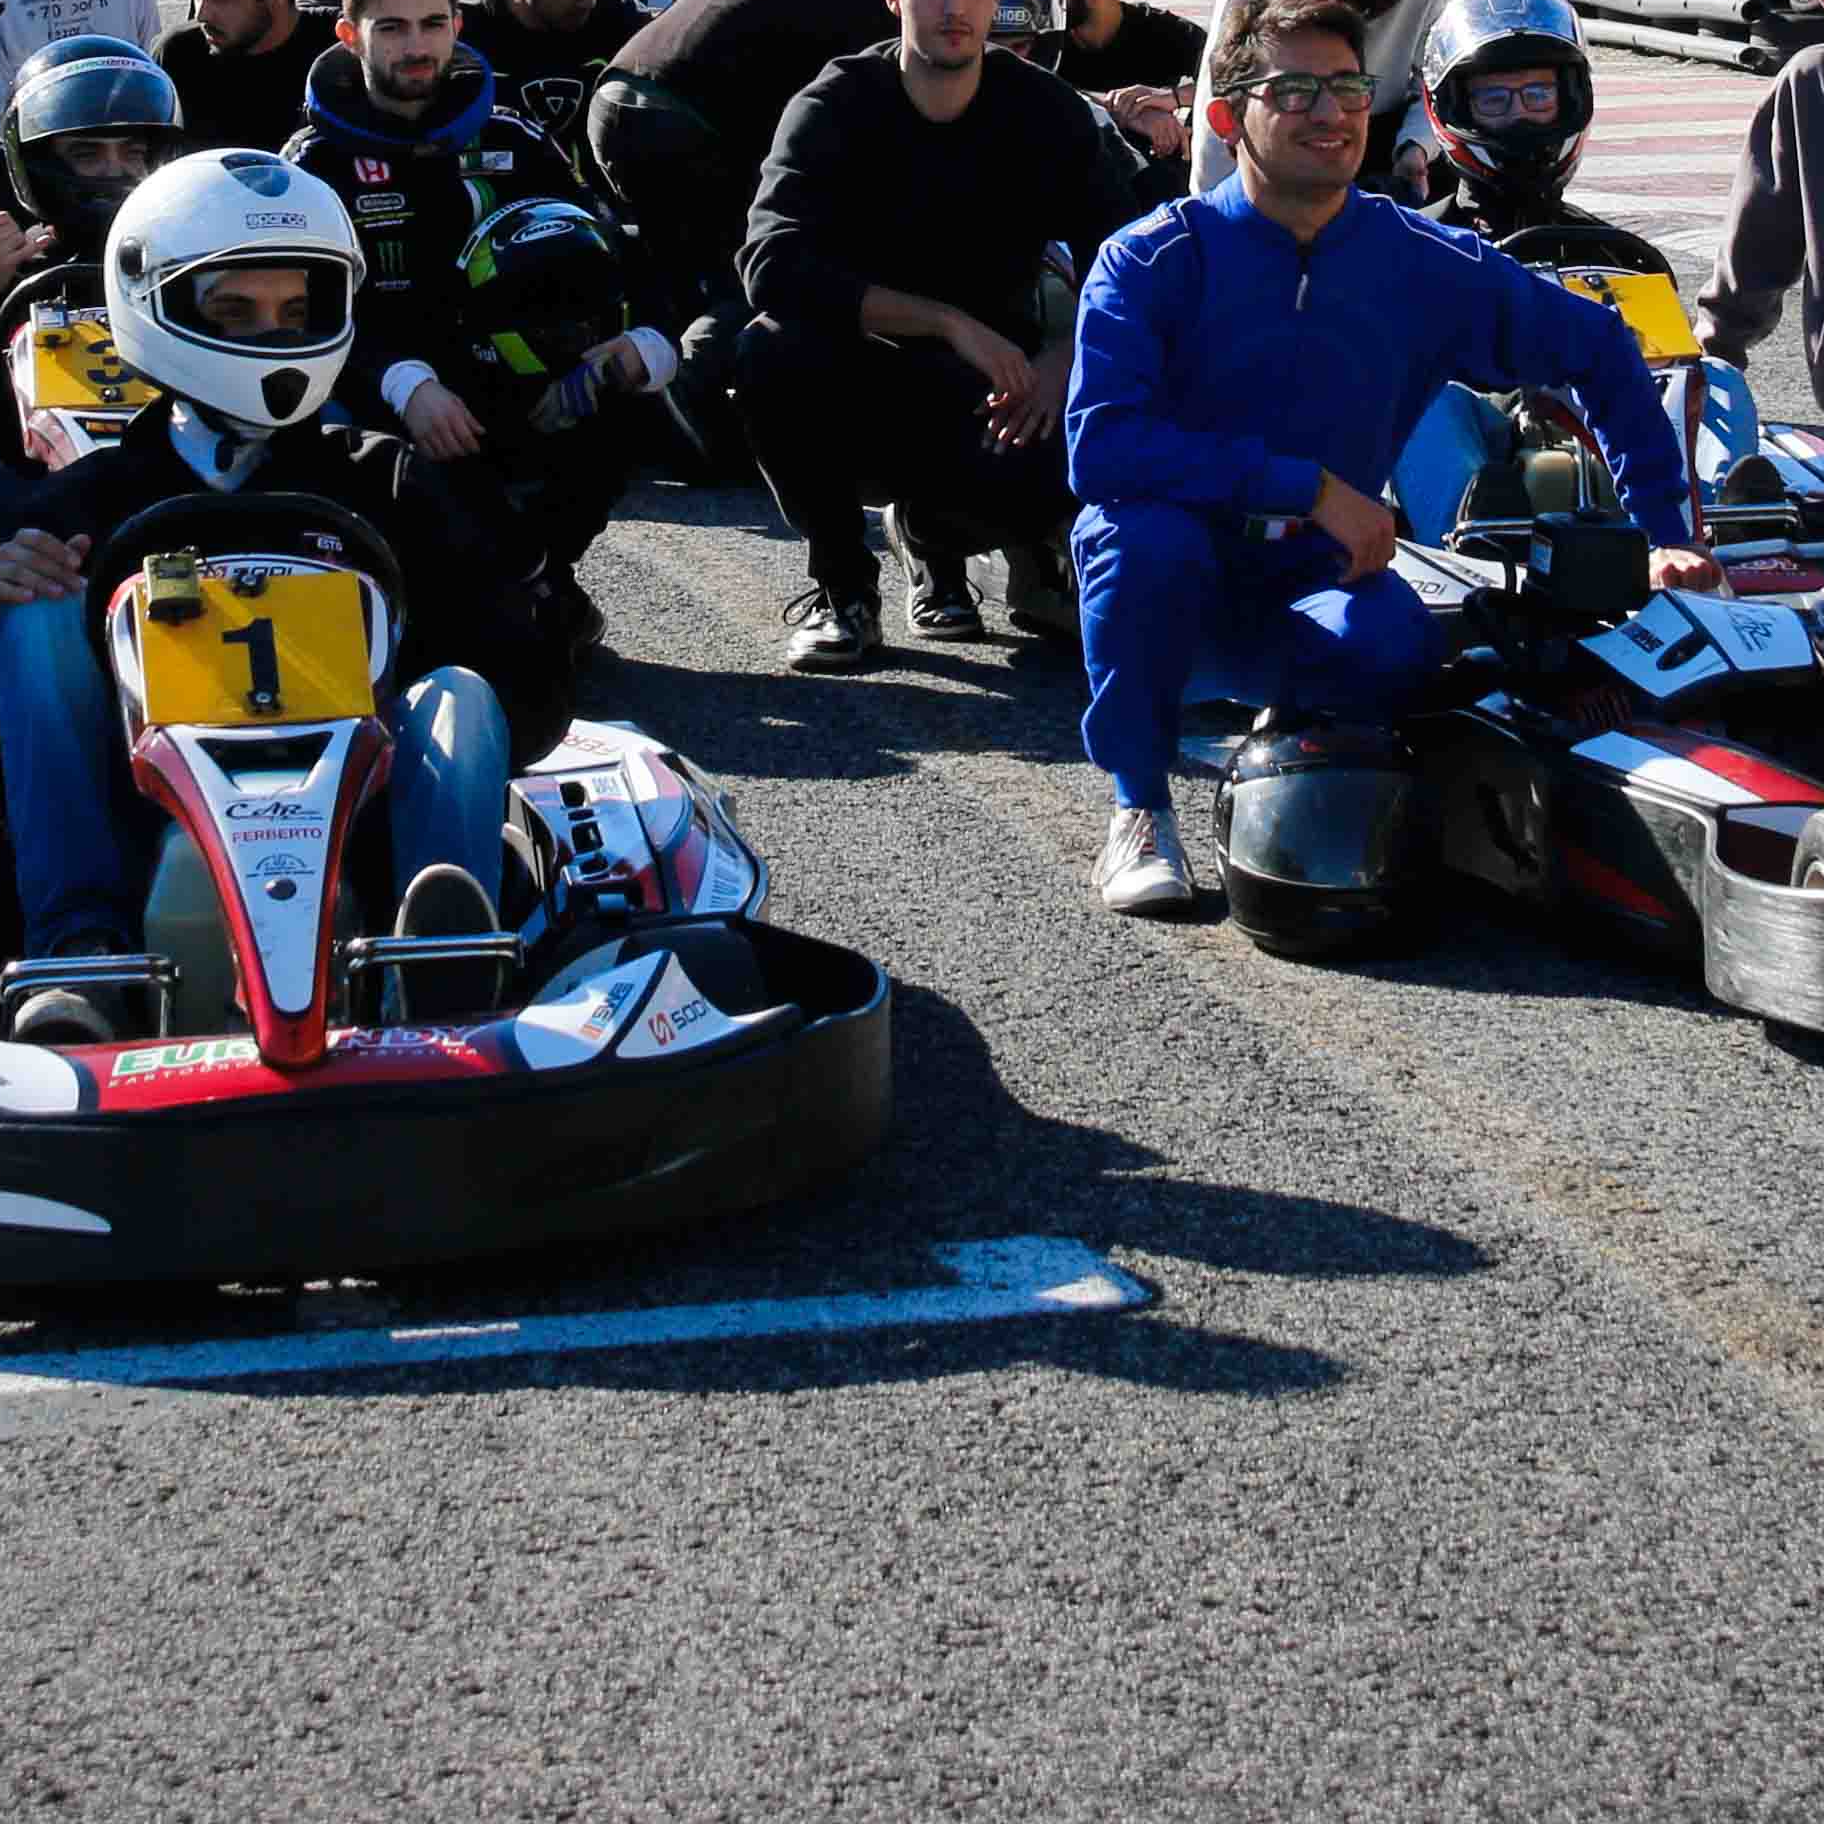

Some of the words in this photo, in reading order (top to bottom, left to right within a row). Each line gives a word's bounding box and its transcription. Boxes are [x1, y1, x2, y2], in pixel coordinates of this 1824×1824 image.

[85, 338, 142, 386] 3
[1412, 578, 1448, 596] ODI
[221, 617, 282, 712] 1
[231, 827, 323, 843] FERBERTO
